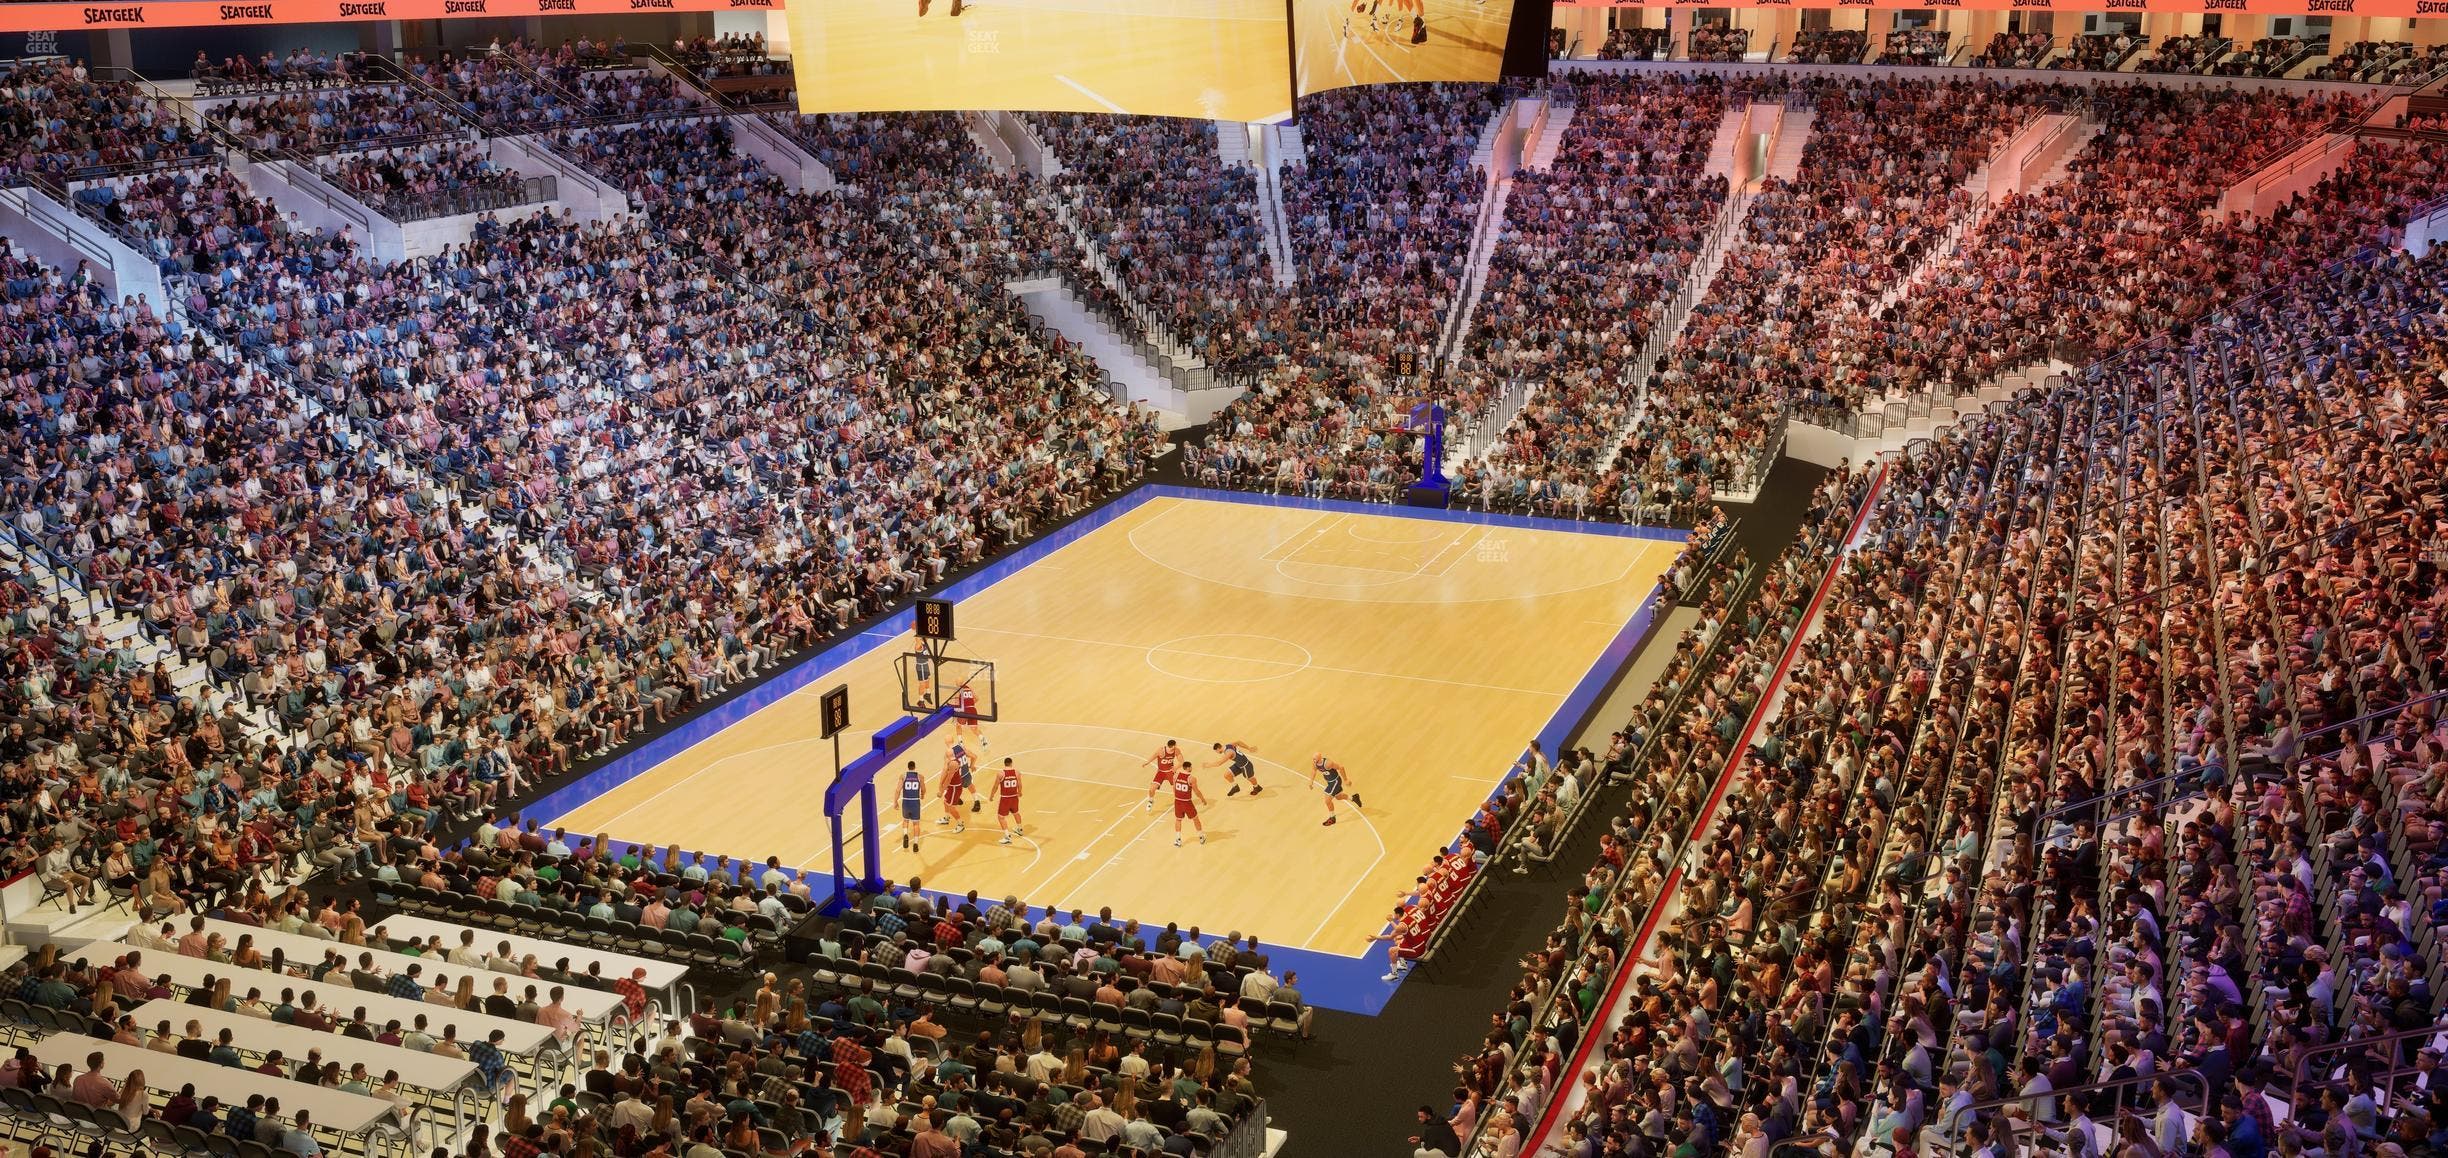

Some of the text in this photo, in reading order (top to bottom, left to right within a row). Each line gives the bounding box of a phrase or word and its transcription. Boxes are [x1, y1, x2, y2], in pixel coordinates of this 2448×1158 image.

[340, 2, 386, 17] SEATGEEK
[445, 0, 486, 14] SEATGEEK
[539, 0, 576, 11] SEATGEEK
[631, 0, 674, 9] SEATGEEK
[2106, 0, 2146, 8] SEATGEEK
[2205, 0, 2246, 10] SEATGEEK
[2308, 0, 2354, 12] SEATGEEK
[84, 7, 144, 24] SEATGEEK
[220, 4, 273, 20] SEATGEEK
[928, 616, 939, 634] 88
[904, 781, 919, 790] 00
[1003, 780, 1017, 788] 00
[1175, 783, 1188, 792] 00
